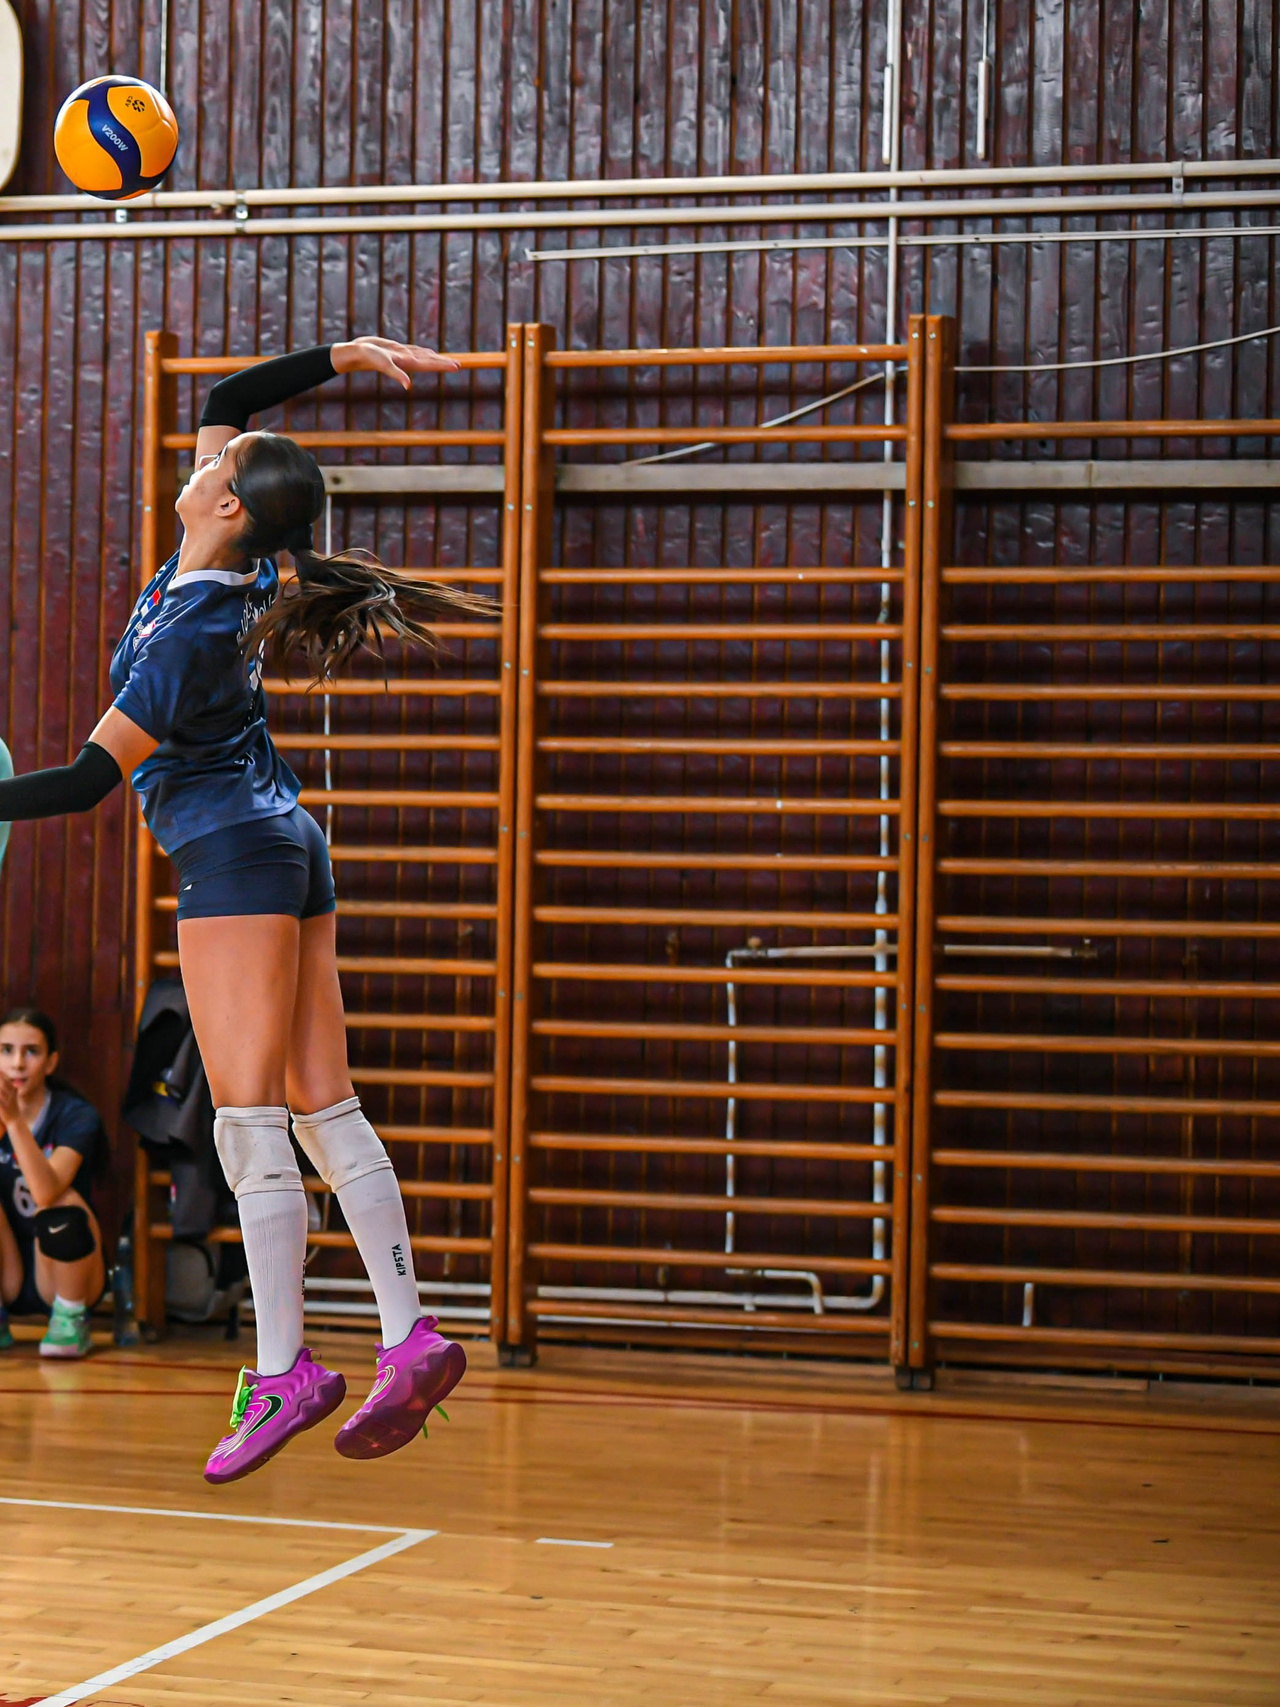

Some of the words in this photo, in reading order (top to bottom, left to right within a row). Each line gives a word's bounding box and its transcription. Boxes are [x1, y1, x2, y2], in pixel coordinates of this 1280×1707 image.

[101, 124, 128, 151] V200W
[14, 1176, 38, 1217] 6
[391, 1243, 407, 1277] KIPSTA
